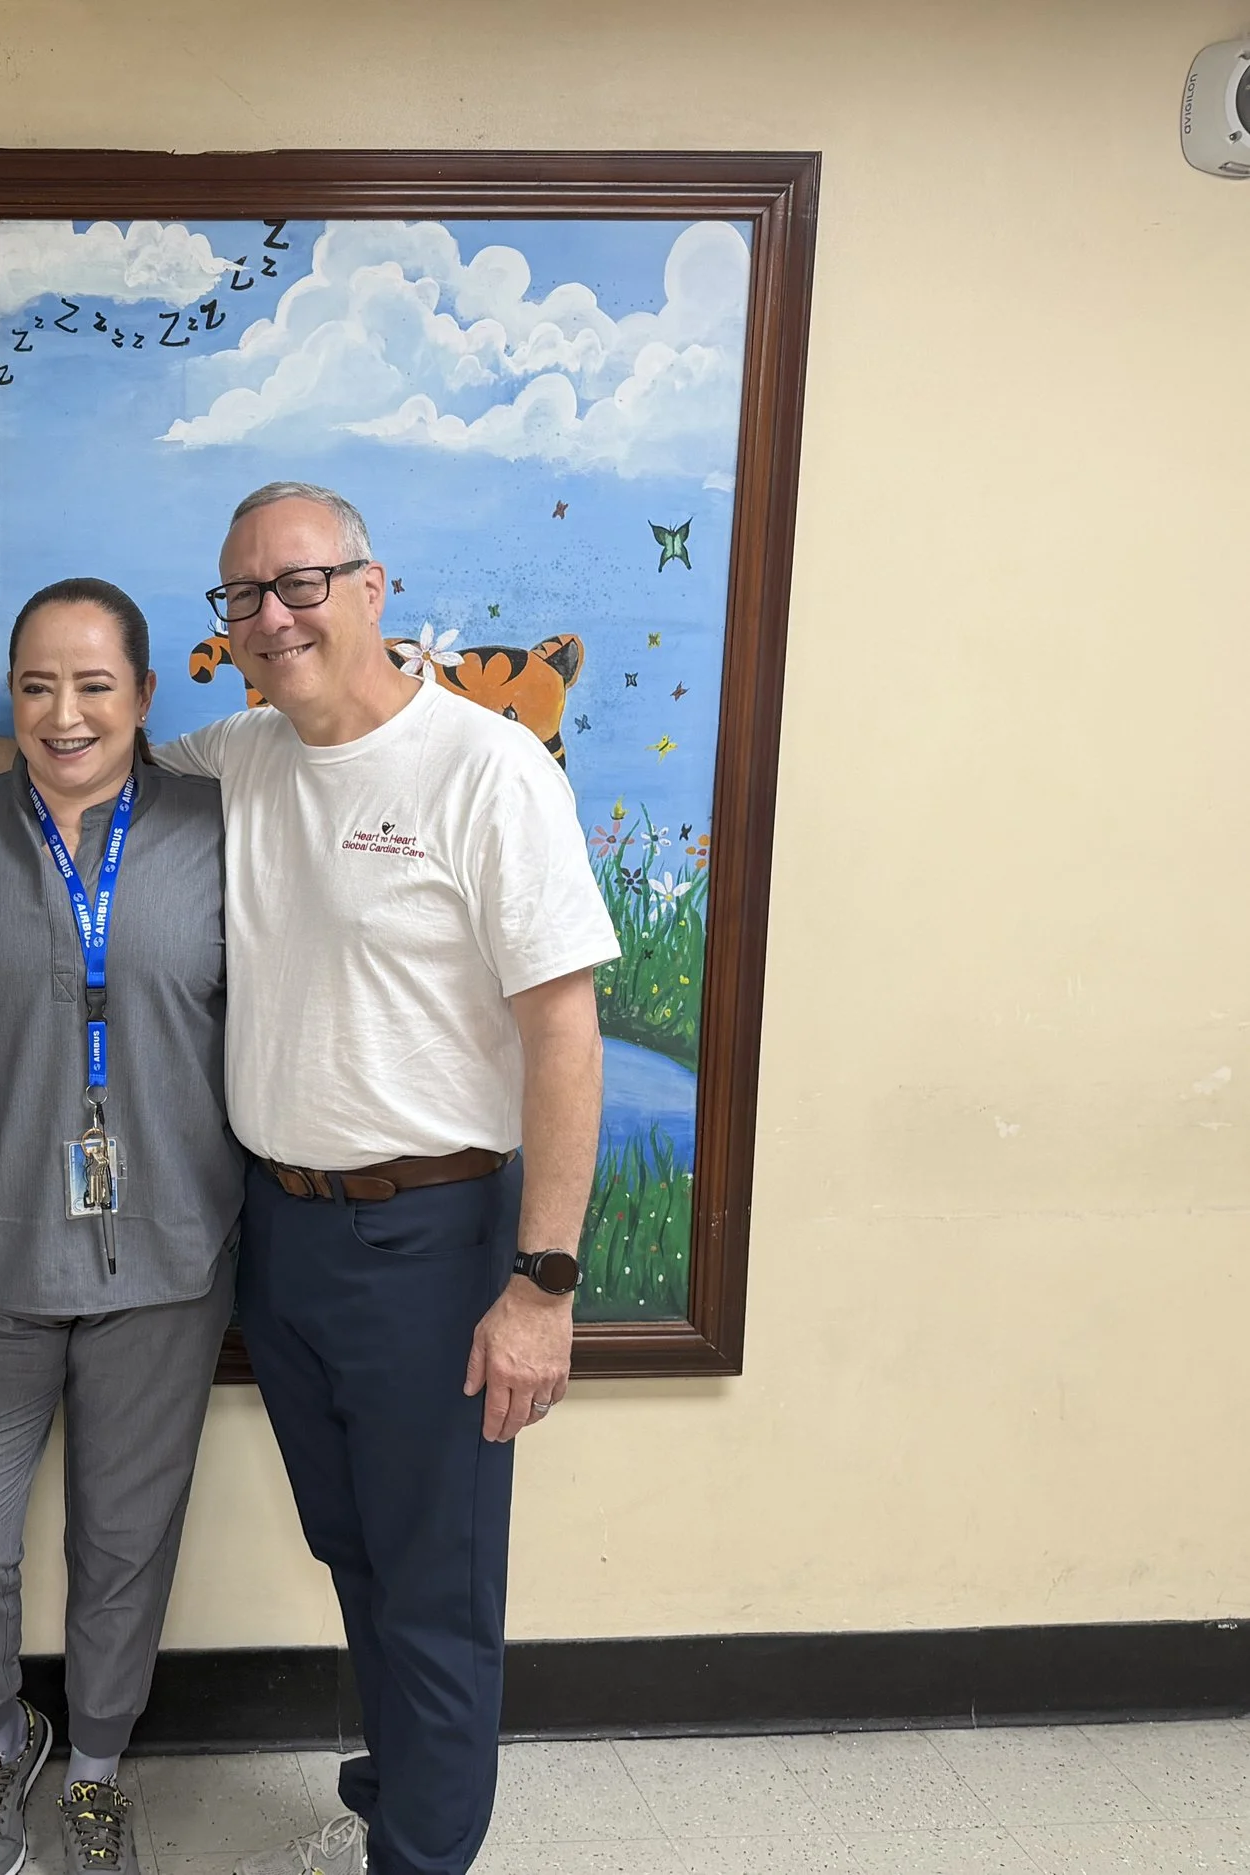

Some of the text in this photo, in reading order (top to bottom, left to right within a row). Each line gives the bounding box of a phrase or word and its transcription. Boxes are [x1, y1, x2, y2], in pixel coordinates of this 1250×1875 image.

[30, 787, 47, 821] AIRBUS
[122, 773, 135, 803] AIRBU
[108, 827, 124, 864] AIRBUS
[342, 840, 425, 858] Global Cardiac Care
[353, 830, 380, 842] Heart
[389, 834, 416, 846] Heart
[53, 844, 73, 878] AIRBUS
[95, 891, 110, 935] AIRBUS
